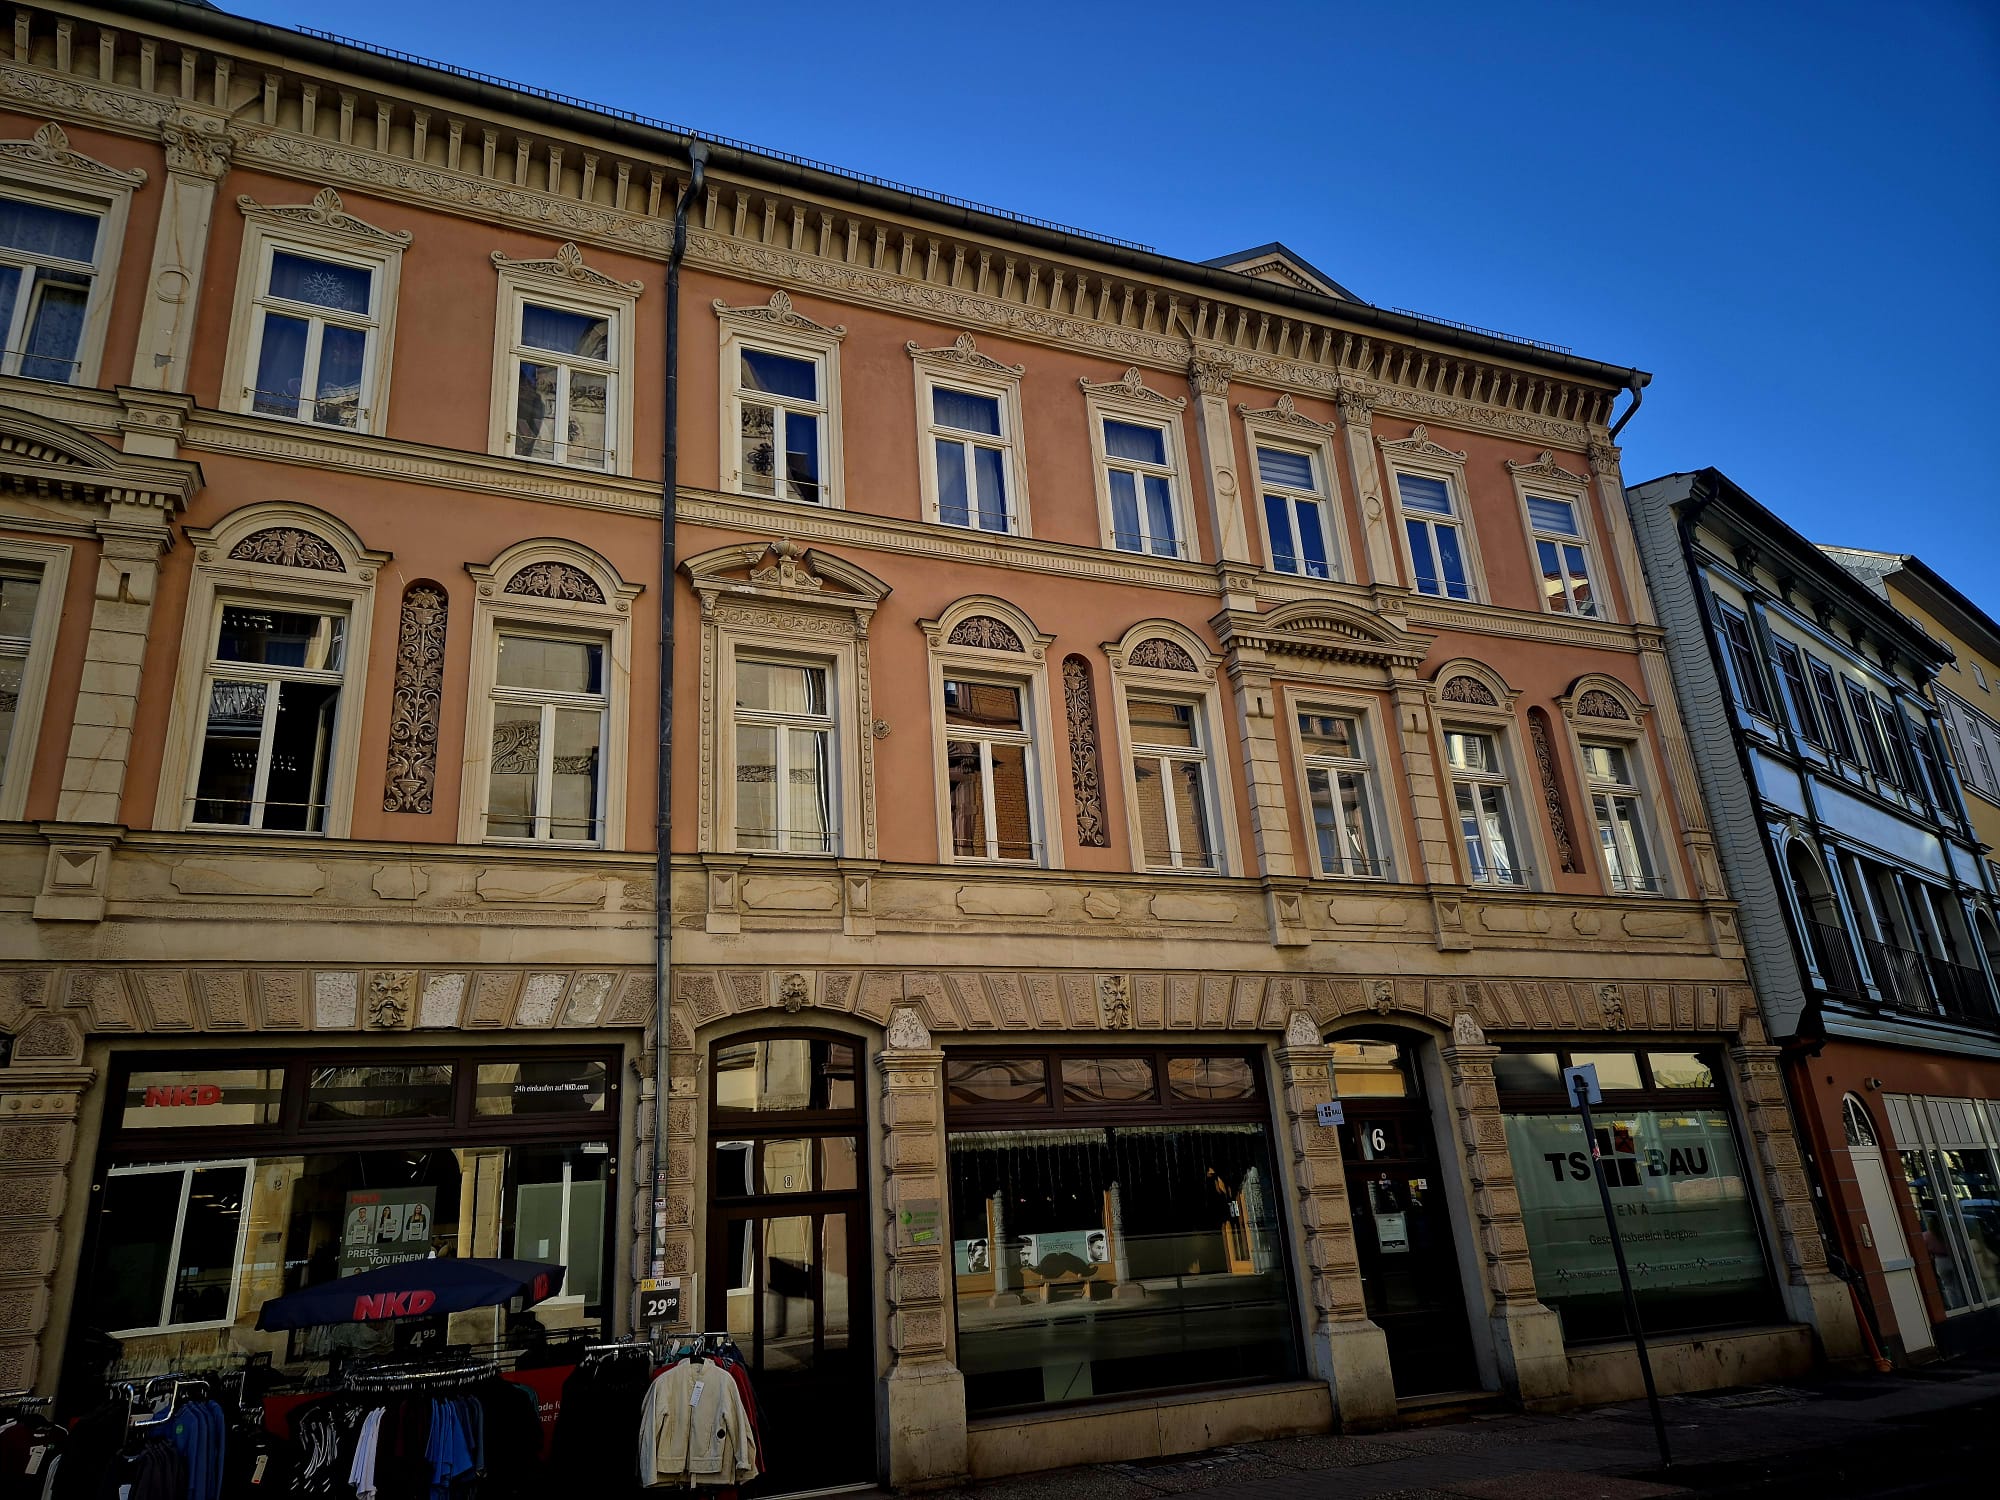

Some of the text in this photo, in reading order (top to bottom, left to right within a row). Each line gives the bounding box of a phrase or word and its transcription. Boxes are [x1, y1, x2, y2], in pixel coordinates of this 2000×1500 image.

[564, 1083, 589, 1091] NKD.com
[145, 1085, 221, 1107] NKD
[1371, 1128, 1386, 1151] 6
[1544, 1147, 1709, 1182] TS BAU
[1612, 1203, 1649, 1217] ENA
[347, 1248, 380, 1258] PREISE
[369, 1253, 424, 1265] VON IHNEN!
[656, 1279, 672, 1288] Alles
[353, 1289, 437, 1322] NKD
